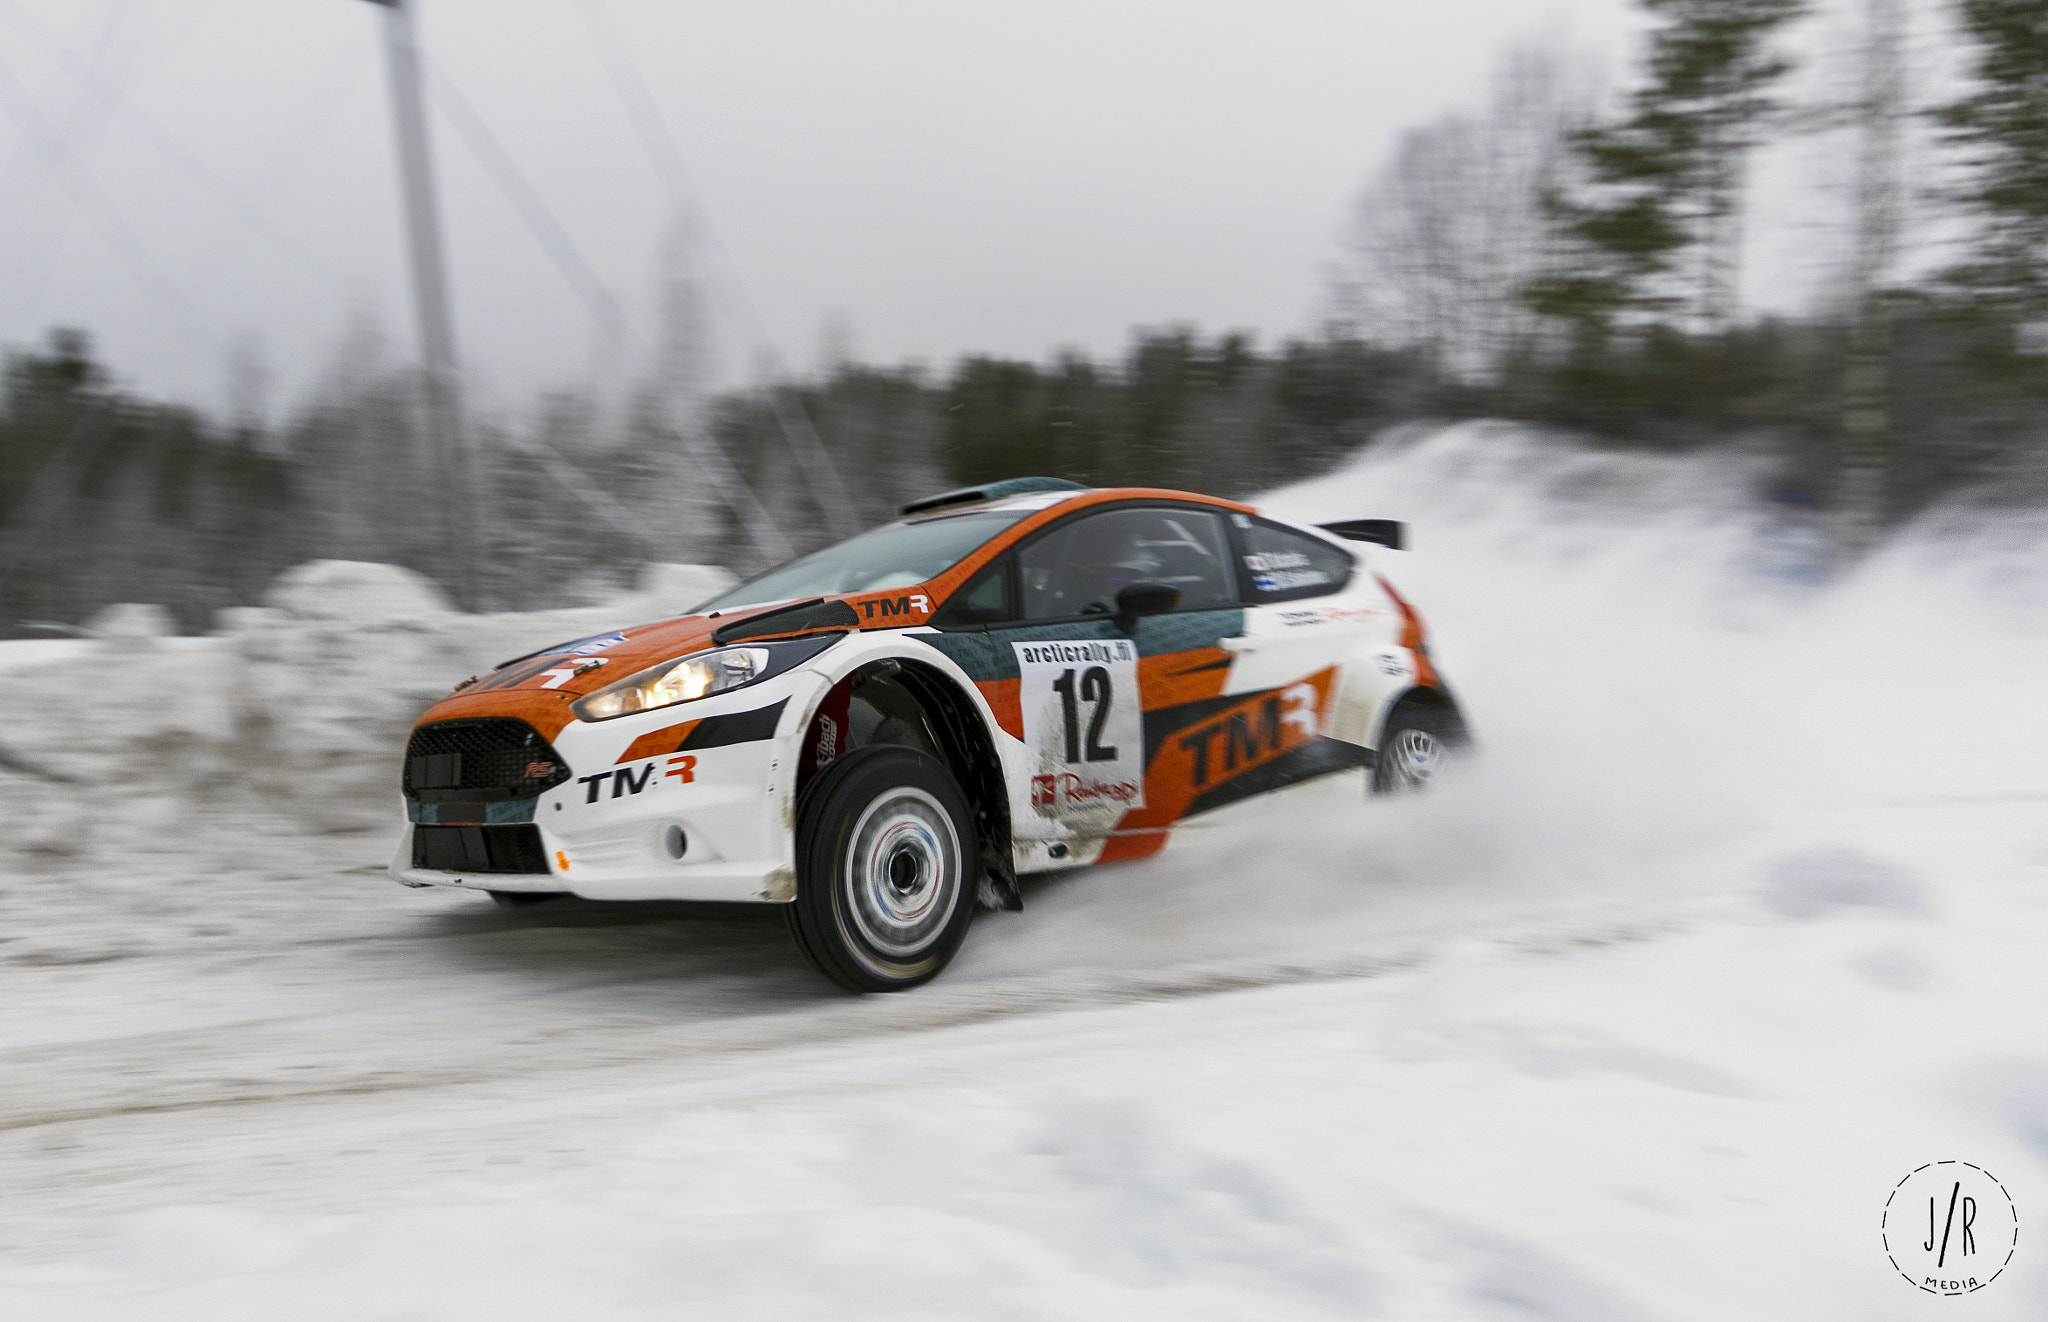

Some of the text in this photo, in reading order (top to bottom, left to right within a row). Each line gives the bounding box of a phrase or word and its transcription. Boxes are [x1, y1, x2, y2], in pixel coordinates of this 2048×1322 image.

[857, 594, 929, 618] TMR
[1052, 666, 1118, 764] 12
[1181, 681, 1320, 788] TMR
[523, 762, 552, 778] RS
[577, 755, 698, 805] TMR
